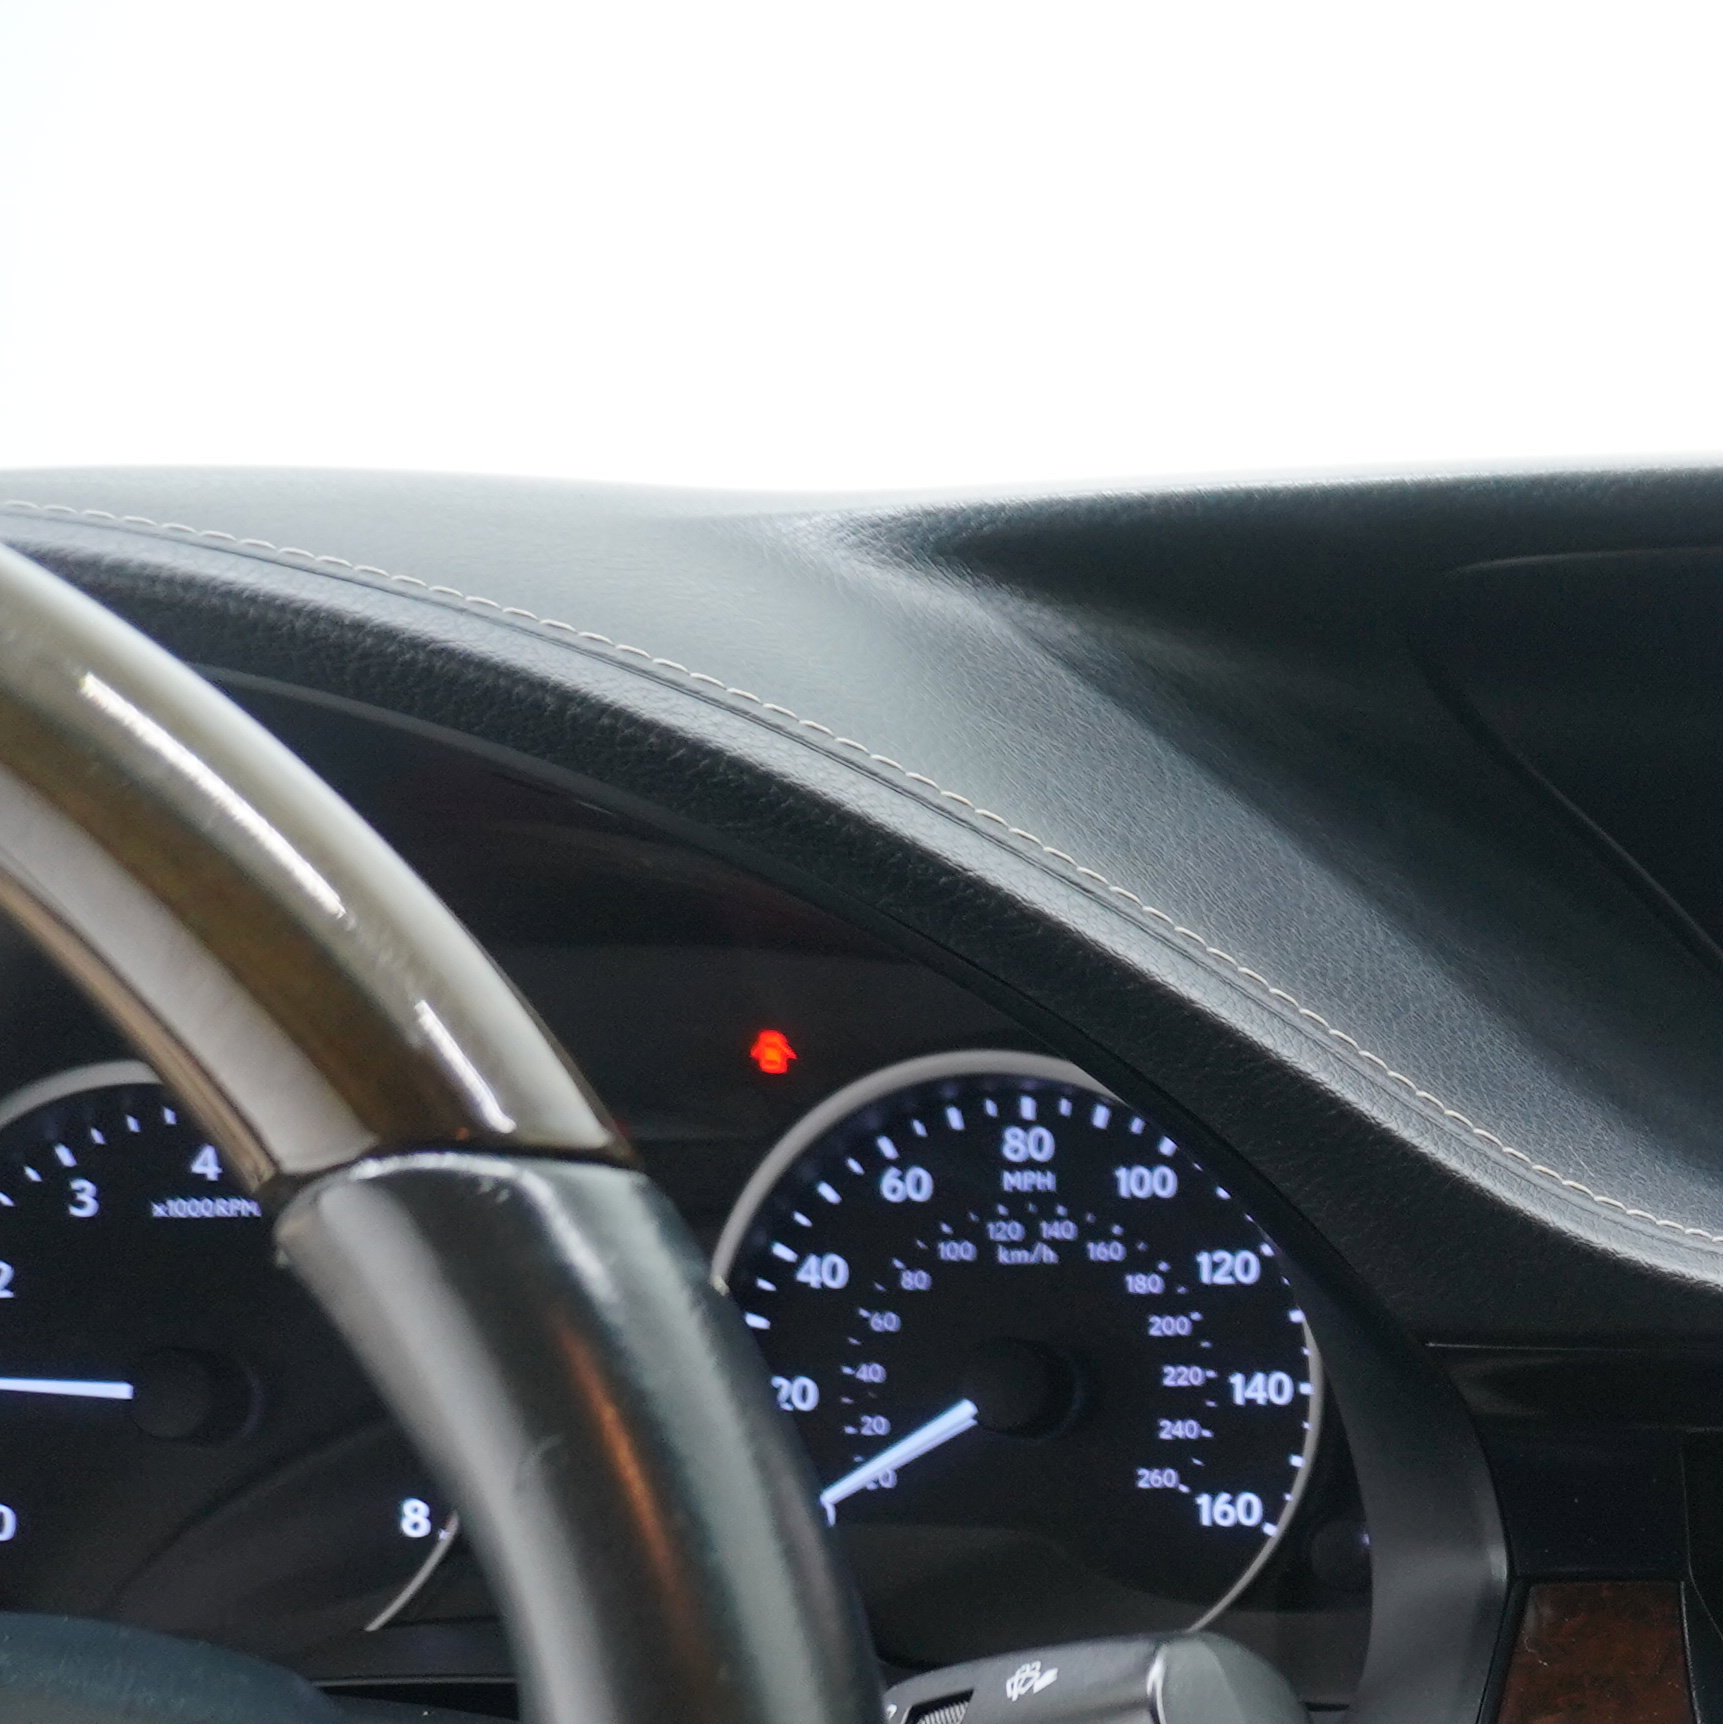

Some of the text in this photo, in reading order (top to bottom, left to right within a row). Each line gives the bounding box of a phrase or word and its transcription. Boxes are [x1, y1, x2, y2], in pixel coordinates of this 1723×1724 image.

[1001, 1128, 1056, 1164] 80
[191, 1144, 222, 1182] 4
[880, 1165, 934, 1202] 60
[1001, 1169, 1057, 1193] MPH
[1115, 1165, 1177, 1200] 100
[68, 1178, 99, 1219] 3
[987, 1220, 1024, 1241] 120
[1039, 1220, 1076, 1241] 140
[938, 1240, 977, 1263] 100
[997, 1241, 1059, 1265] km/h
[1086, 1240, 1126, 1263] 160
[796, 1252, 849, 1290] 40
[1197, 1250, 1260, 1286] 120
[900, 1269, 932, 1293] 80
[1124, 1272, 1165, 1295] 180
[869, 1310, 901, 1333] 60
[1148, 1314, 1192, 1337] 200
[855, 1362, 886, 1384] 40
[1162, 1365, 1205, 1387] 220
[772, 1376, 819, 1413] 20
[1228, 1371, 1293, 1406] 140
[859, 1415, 890, 1436] 20
[1158, 1418, 1199, 1440] 240
[1136, 1467, 1179, 1489] 260
[400, 1498, 431, 1540] 8
[1196, 1492, 1263, 1529] 160
